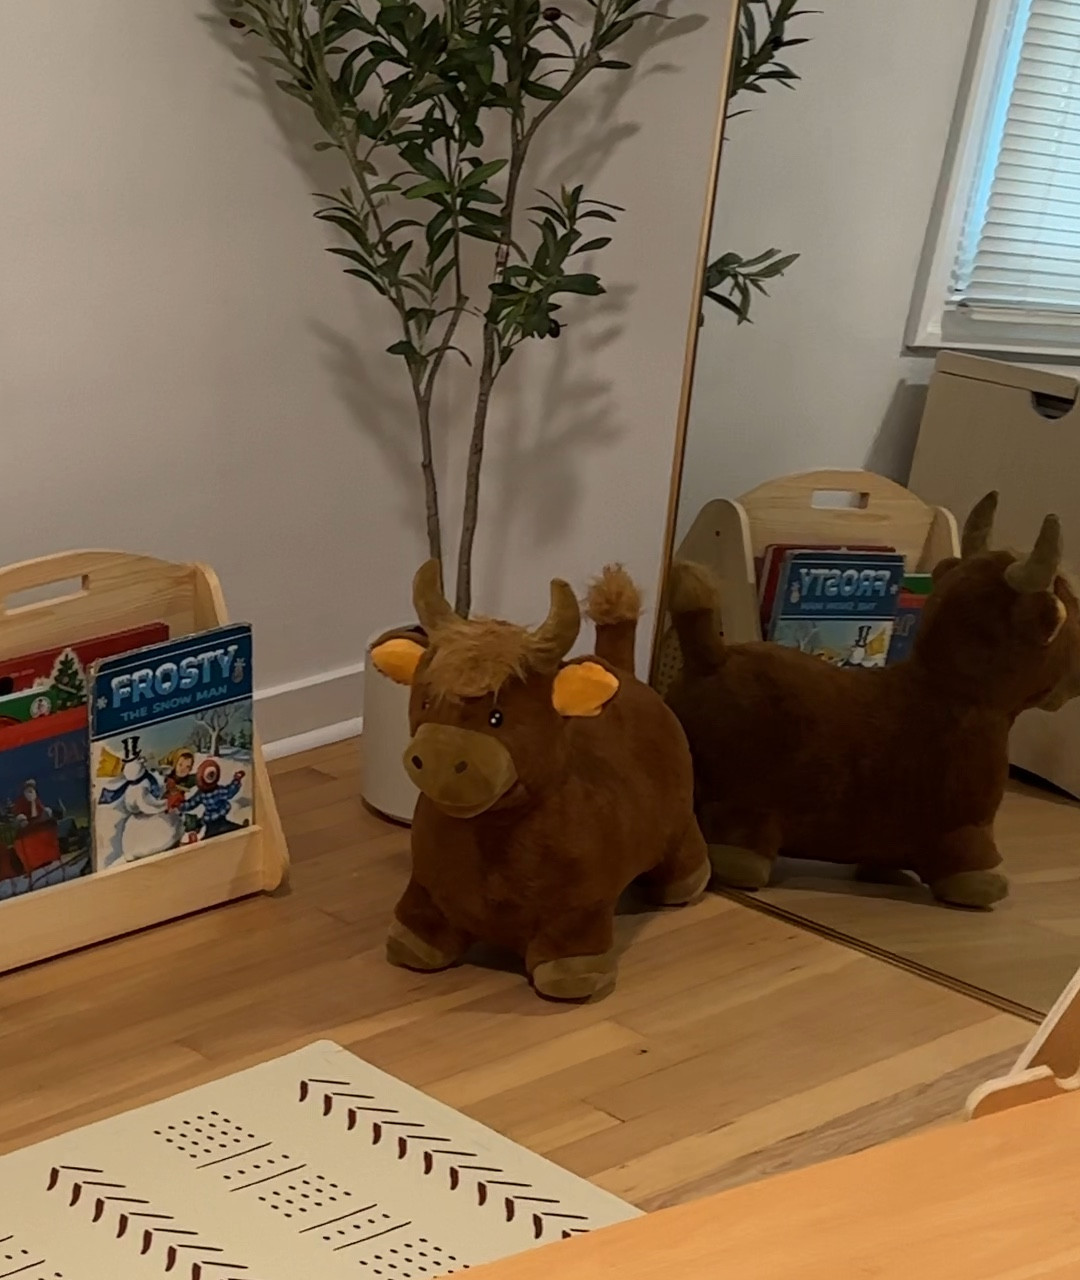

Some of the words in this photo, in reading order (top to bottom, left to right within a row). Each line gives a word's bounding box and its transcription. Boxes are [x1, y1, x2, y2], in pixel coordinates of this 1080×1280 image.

[110, 645, 239, 708] FROSTY
[120, 704, 149, 722] THE
[152, 694, 193, 713] SNOW
[196, 684, 228, 702] MAN
